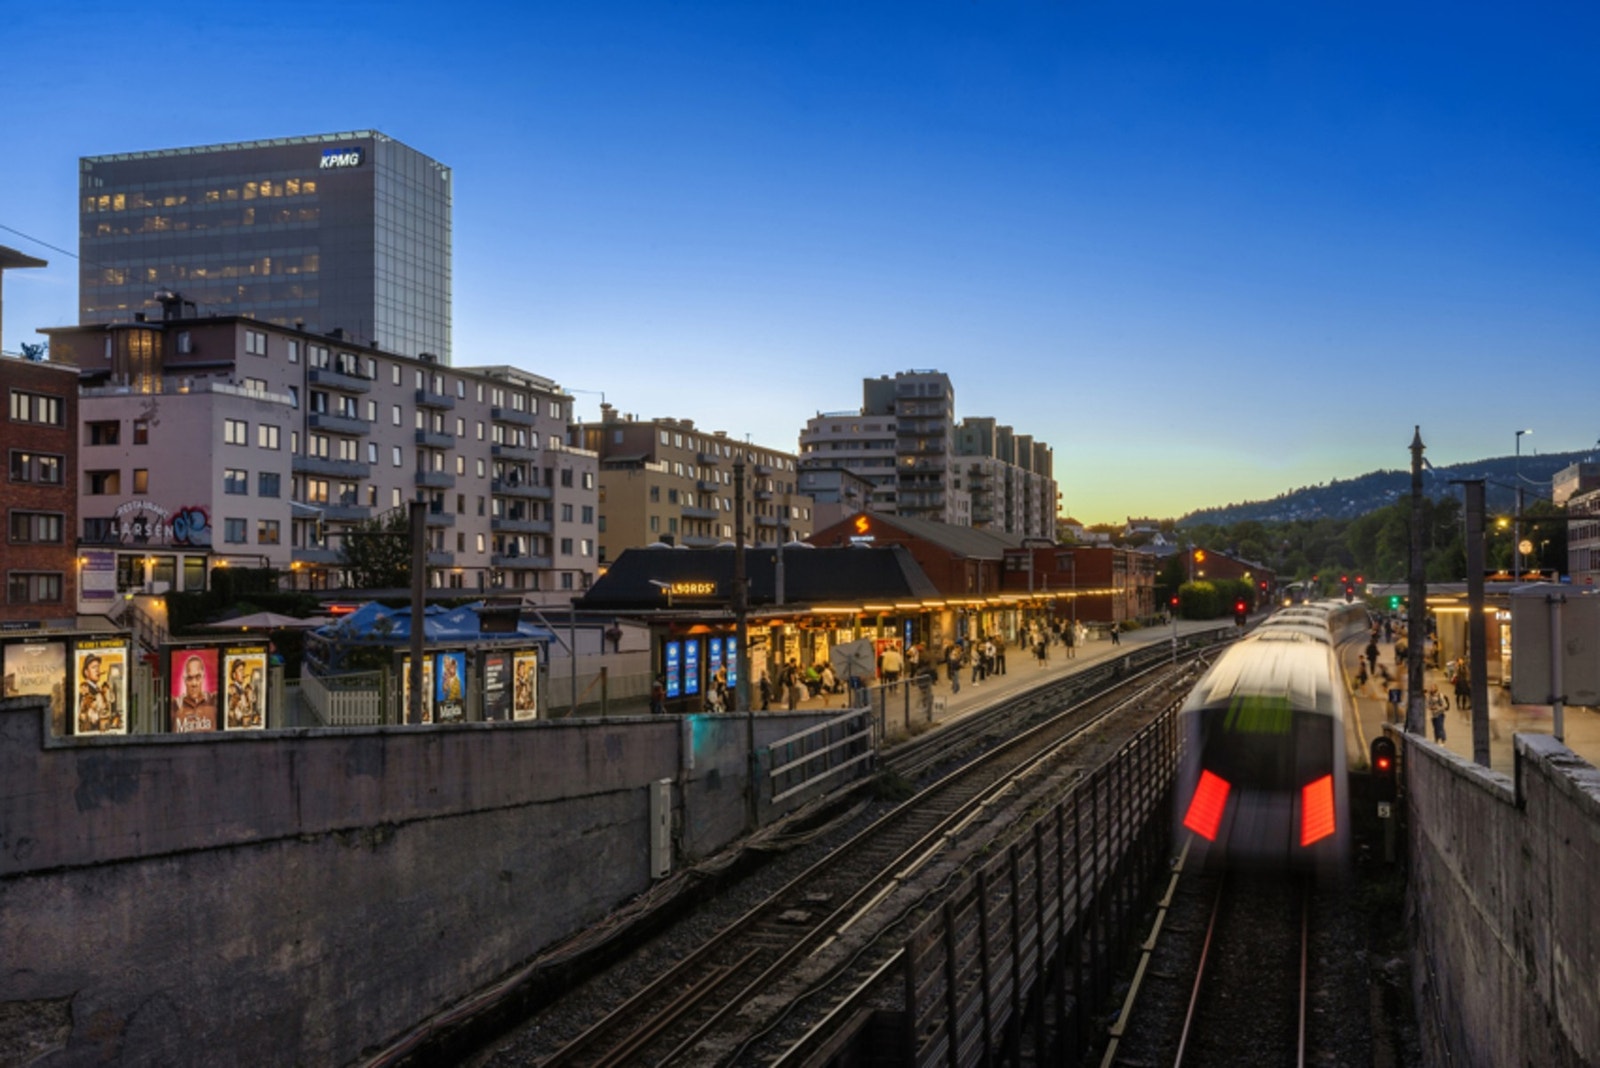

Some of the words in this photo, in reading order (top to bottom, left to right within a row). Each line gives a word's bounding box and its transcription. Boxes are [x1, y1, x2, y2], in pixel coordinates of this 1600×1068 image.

[320, 153, 359, 168] KPMG
[117, 500, 168, 518] RESTAURANT
[111, 521, 173, 537] LARSEN
